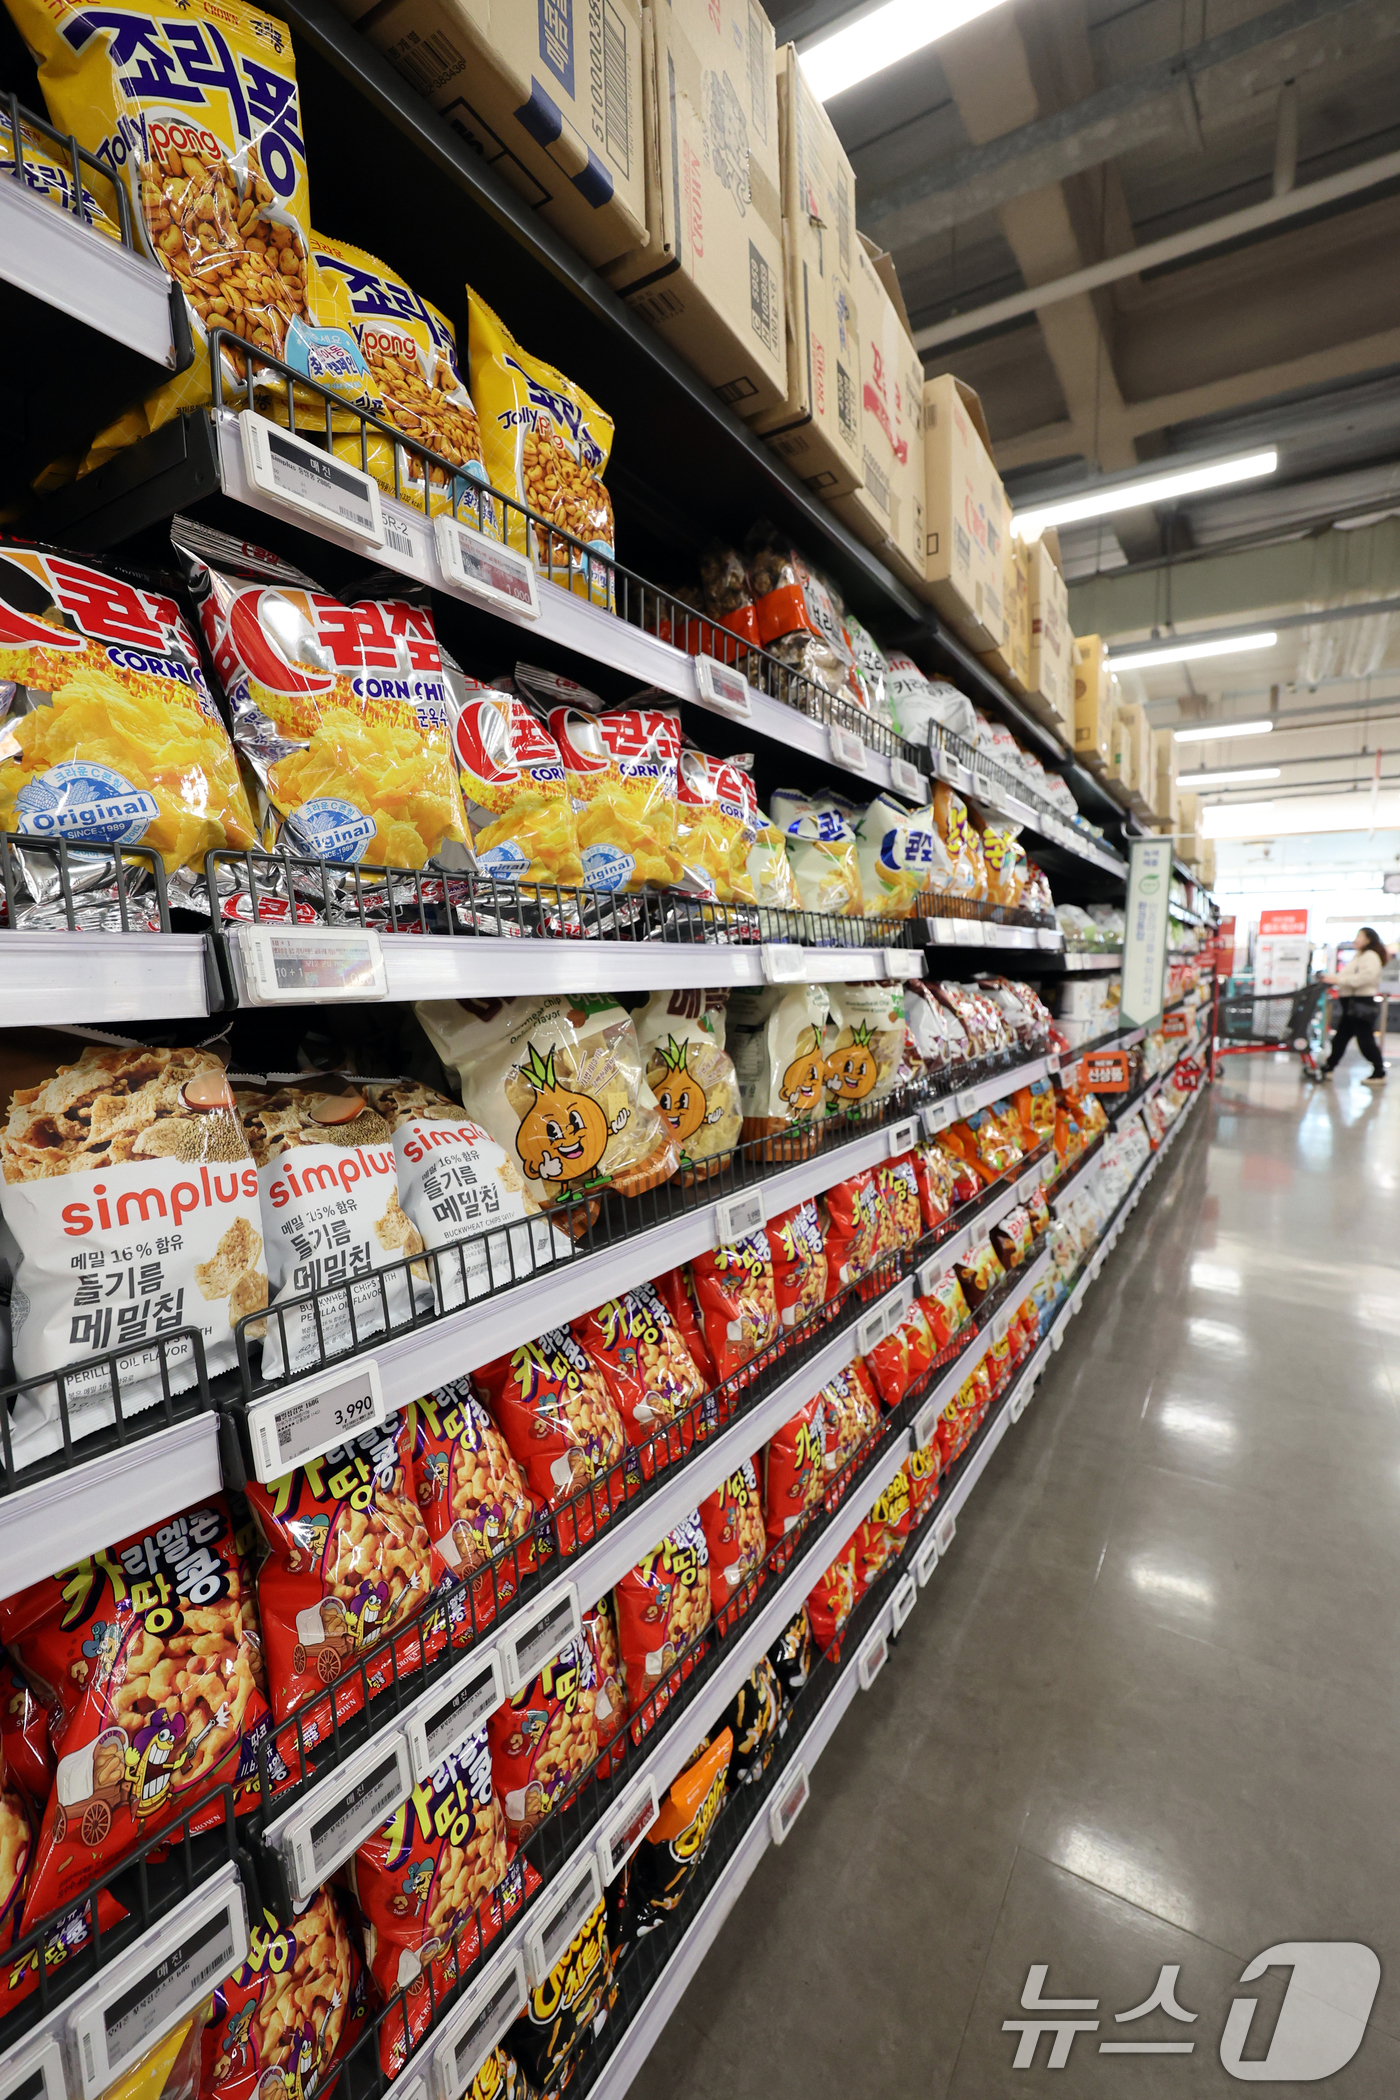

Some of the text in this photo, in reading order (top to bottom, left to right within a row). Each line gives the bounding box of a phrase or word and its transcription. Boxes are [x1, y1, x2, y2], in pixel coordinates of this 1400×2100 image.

[588, 0, 604, 143] 51000038
[60, 10, 308, 198] 죠리퐁
[96, 112, 150, 172] Jolly
[149, 122, 223, 162] pong
[364, 331, 416, 360] pong
[498, 407, 538, 433] Jolly
[106, 648, 188, 682] CORN
[353, 678, 409, 699] CORN
[54, 766, 89, 783] 크라운
[33, 796, 148, 830] Original
[67, 822, 126, 840] SINCE 1989
[544, 996, 562, 1009] Chip
[461, 1149, 481, 1163] 함유
[270, 1147, 396, 1208] simplus
[423, 1165, 478, 1201] 들기름
[62, 1166, 259, 1236] simplus
[281, 1212, 304, 1236] 메밀
[335, 1198, 358, 1221] 함유
[432, 1182, 500, 1222] 메밀칩
[289, 1219, 352, 1262] 들기름
[443, 1221, 484, 1239] BUCKWHEAT
[70, 1251, 105, 1270] 메밀
[155, 1234, 184, 1256] 함유
[293, 1240, 372, 1292] 메밀칩
[73, 1261, 165, 1307] 들기름
[353, 1279, 377, 1294] CHIPS
[69, 1287, 185, 1350] 메밀칩
[66, 1366, 113, 1386] PERILL
[119, 1358, 140, 1371] OIL
[334, 1395, 372, 1425] 3,990
[131, 1546, 223, 1635] 땅콩
